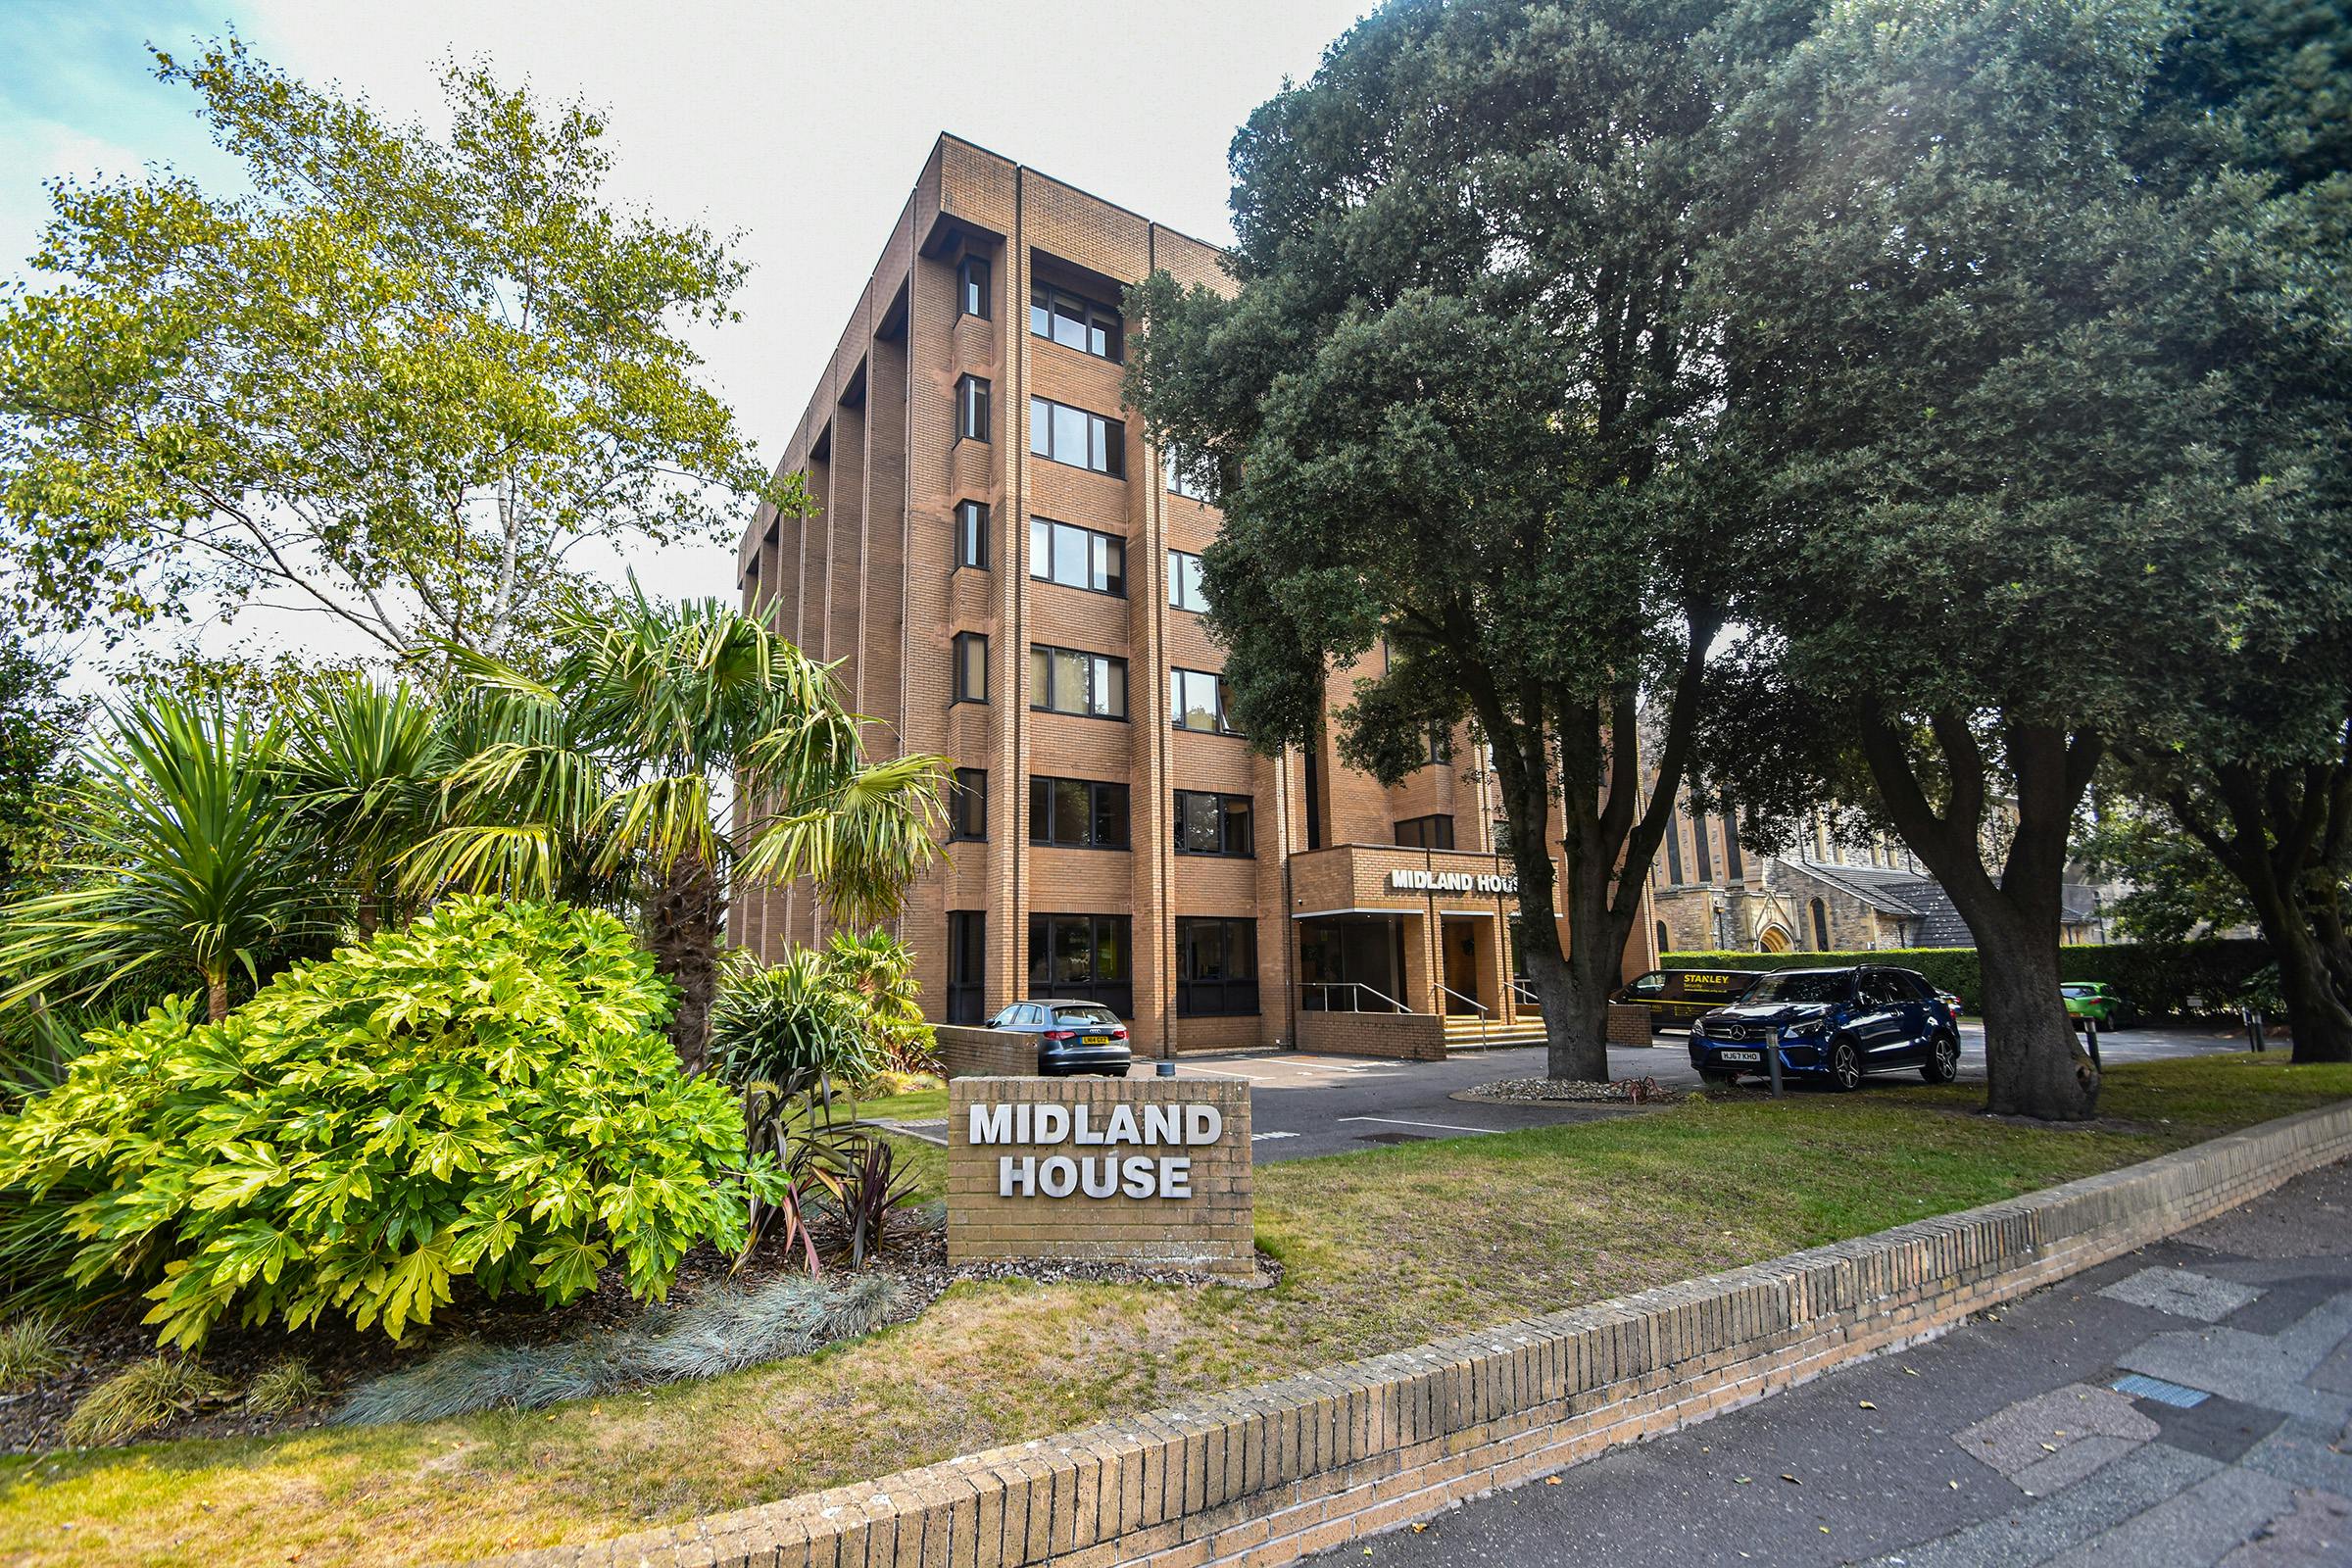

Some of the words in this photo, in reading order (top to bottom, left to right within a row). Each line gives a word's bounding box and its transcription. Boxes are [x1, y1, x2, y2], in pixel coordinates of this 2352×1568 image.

[1392, 869, 1473, 891] MIDLAND
[1477, 874, 1518, 893] HOU
[1684, 974, 1729, 984] STANLEY
[969, 1103, 1223, 1145] MIDLAND
[1000, 1155, 1192, 1200] HOUSE
